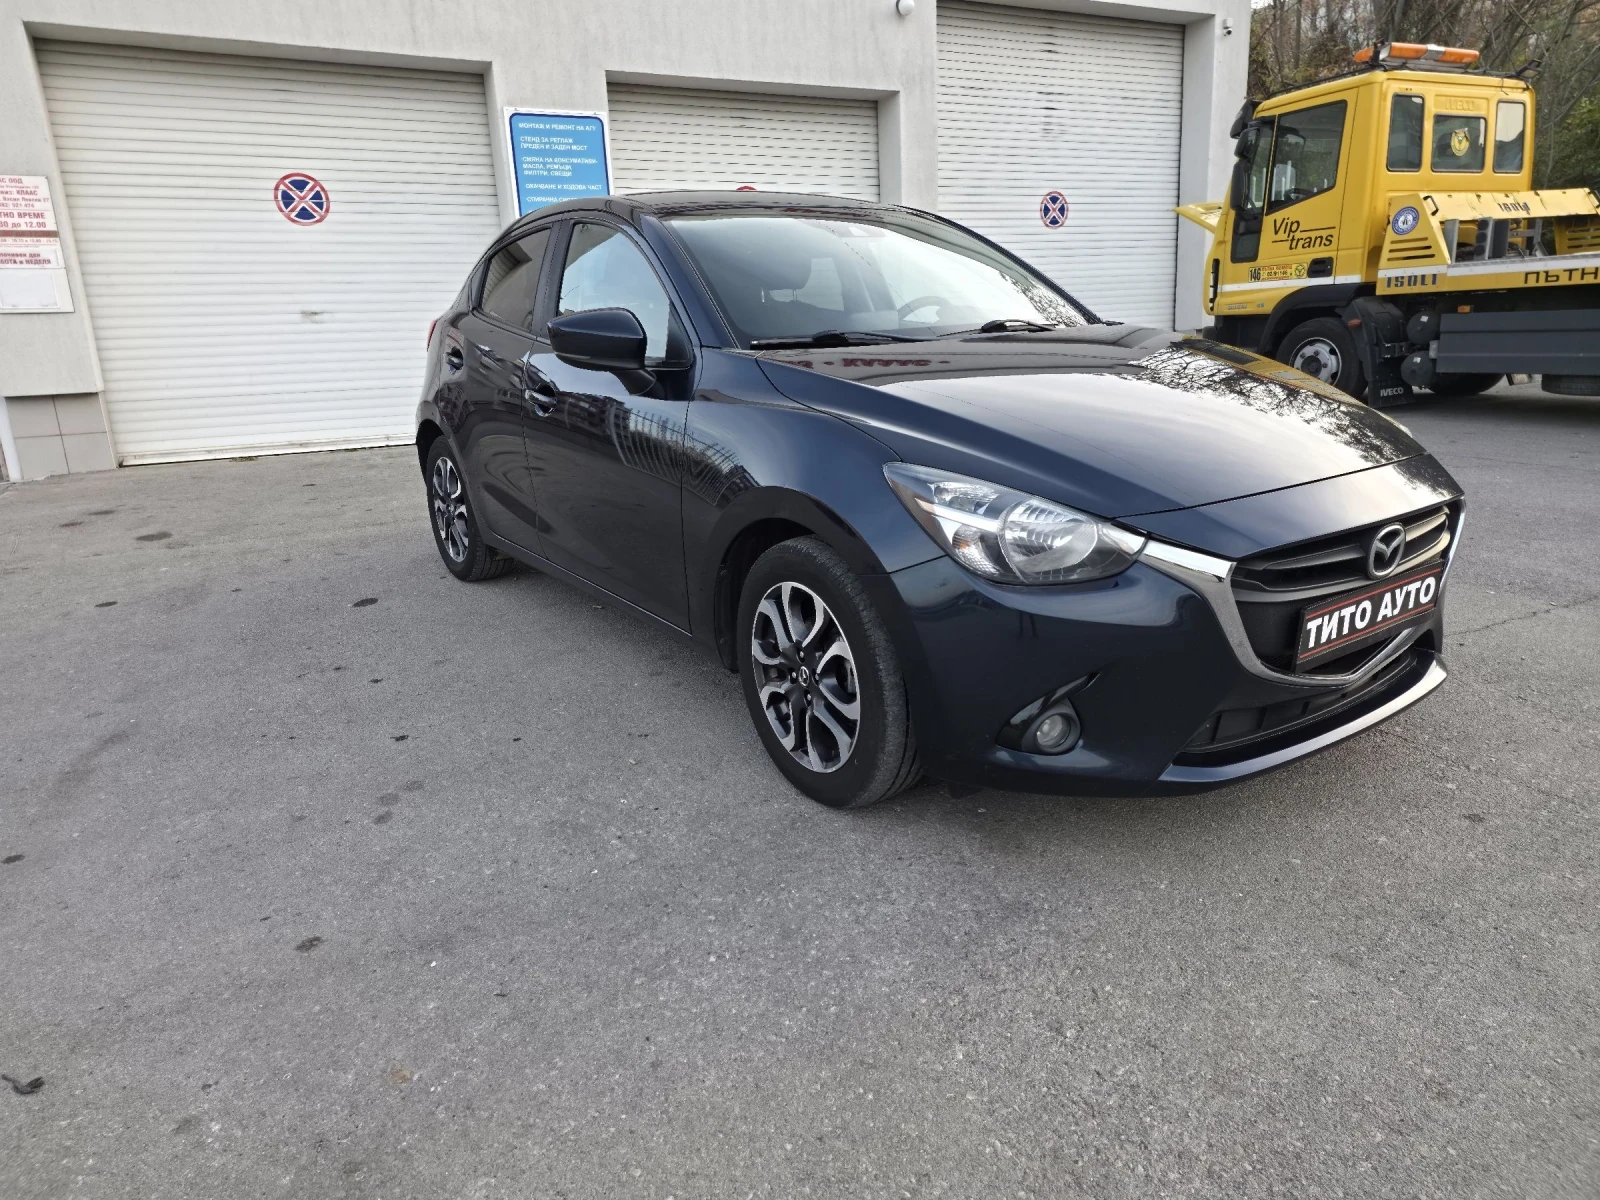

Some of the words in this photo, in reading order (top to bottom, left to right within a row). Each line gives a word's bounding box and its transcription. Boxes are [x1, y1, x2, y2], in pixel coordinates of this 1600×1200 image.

[1273, 217, 1300, 239] Vip
[1289, 233, 1334, 251] trans
[1250, 267, 1261, 282] 146
[1524, 267, 1599, 285] ПЪТН
[1380, 387, 1404, 397] IVECO
[1306, 600, 1372, 649] ТИТО
[1377, 577, 1436, 623] АУТО
